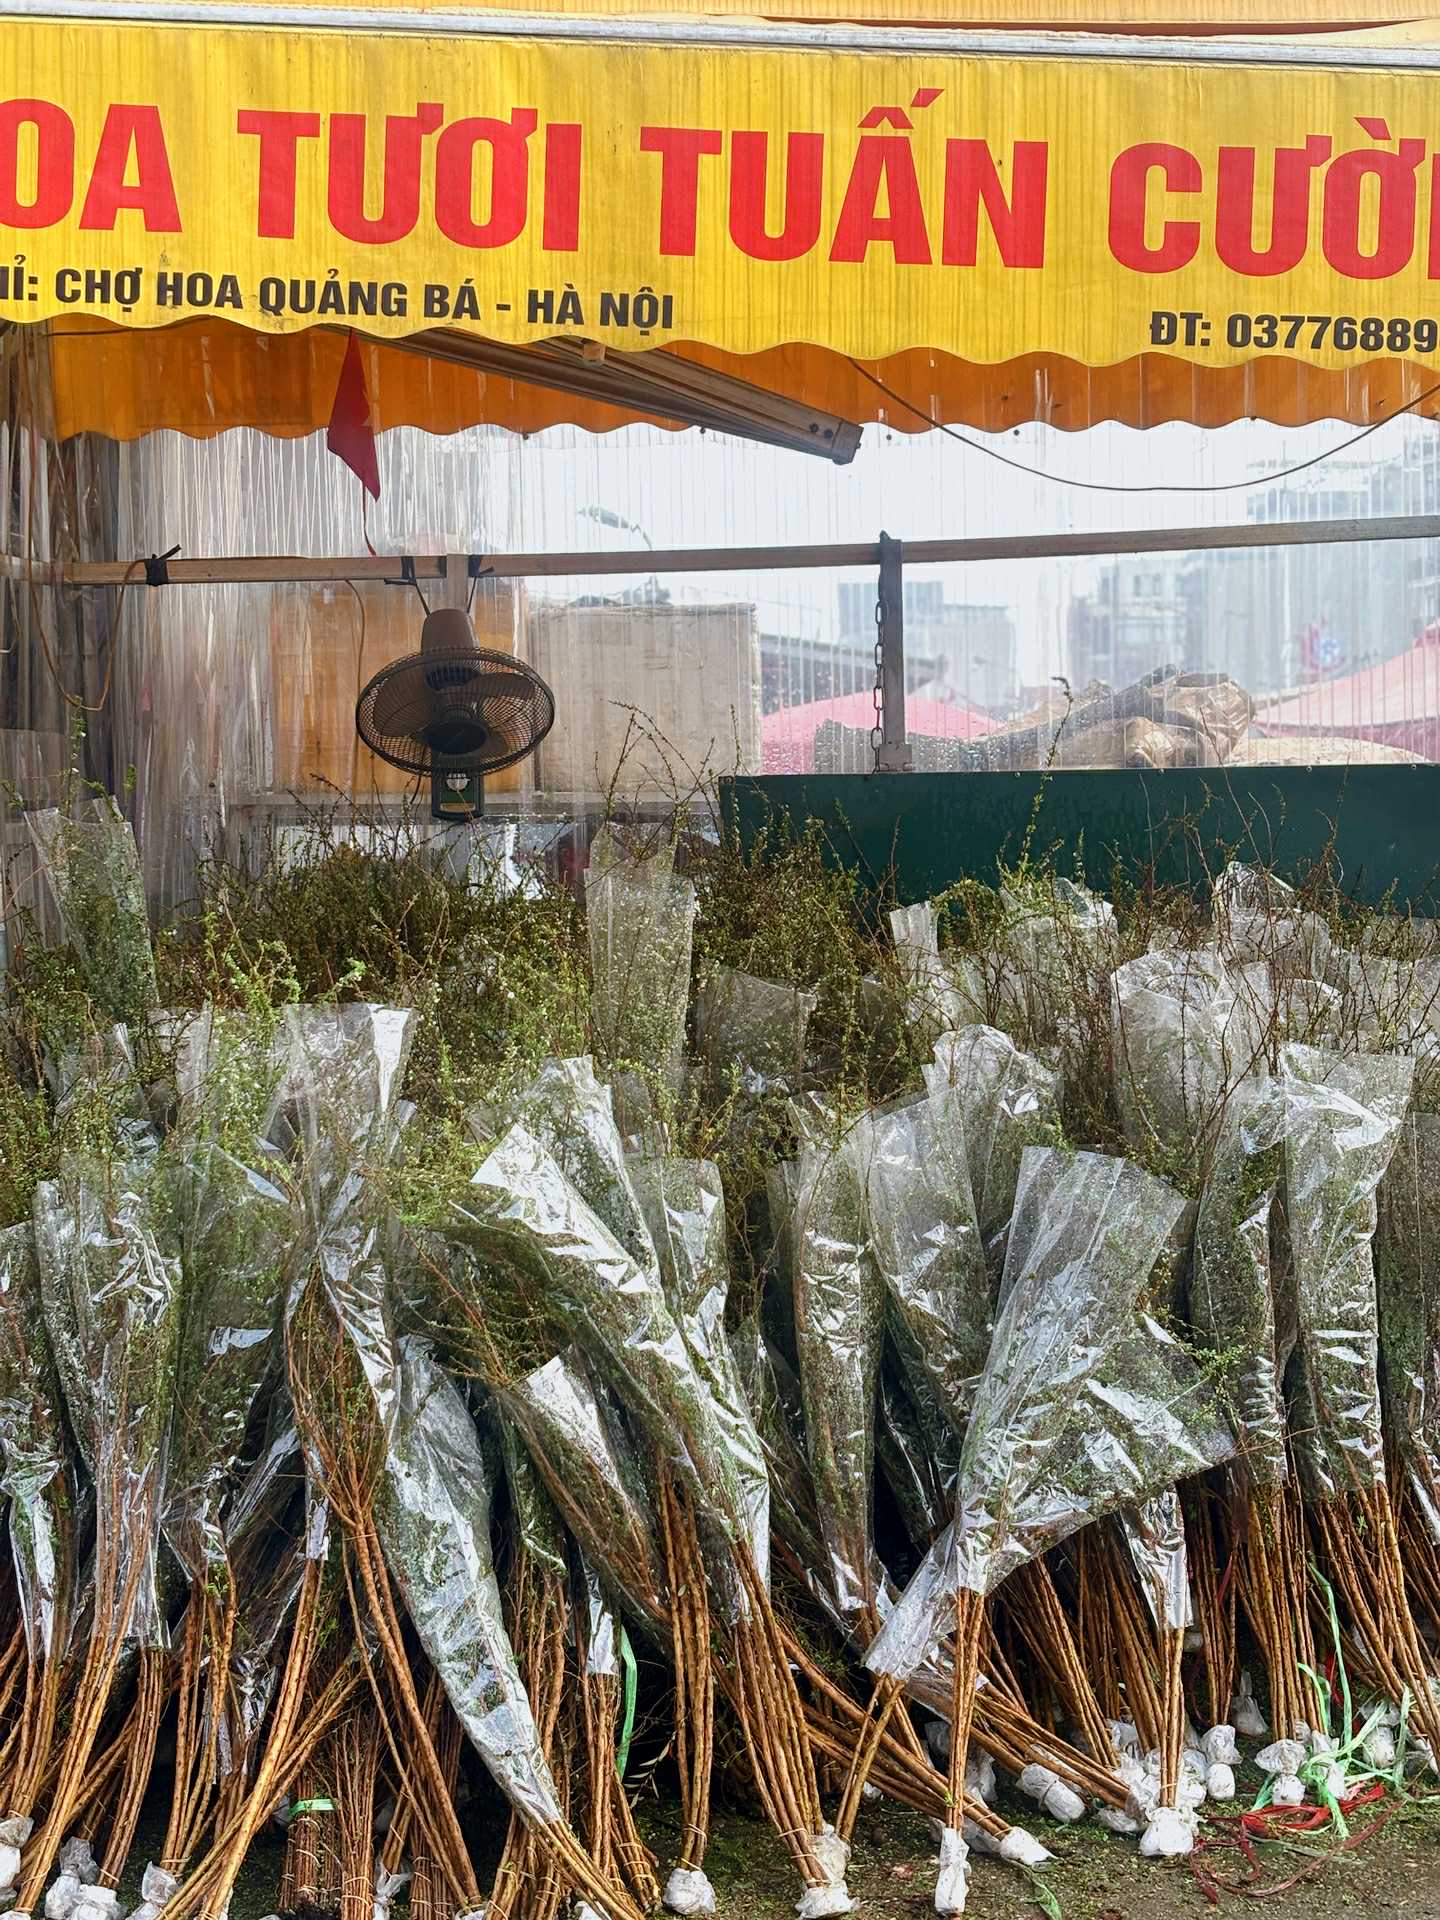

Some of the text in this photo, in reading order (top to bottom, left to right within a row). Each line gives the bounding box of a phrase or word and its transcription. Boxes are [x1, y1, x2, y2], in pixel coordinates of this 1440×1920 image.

[0, 88, 1440, 280] OA TƯƠI TUẤN CƯỜ
[55, 267, 143, 313] CHỢ
[156, 272, 243, 309] HOA
[259, 268, 407, 318] QUẢNG
[423, 279, 481, 321] BÁ
[496, 303, 511, 311] -
[528, 284, 584, 326] HÀ
[599, 290, 673, 336] NỘI
[1149, 311, 1211, 346] ĐT:
